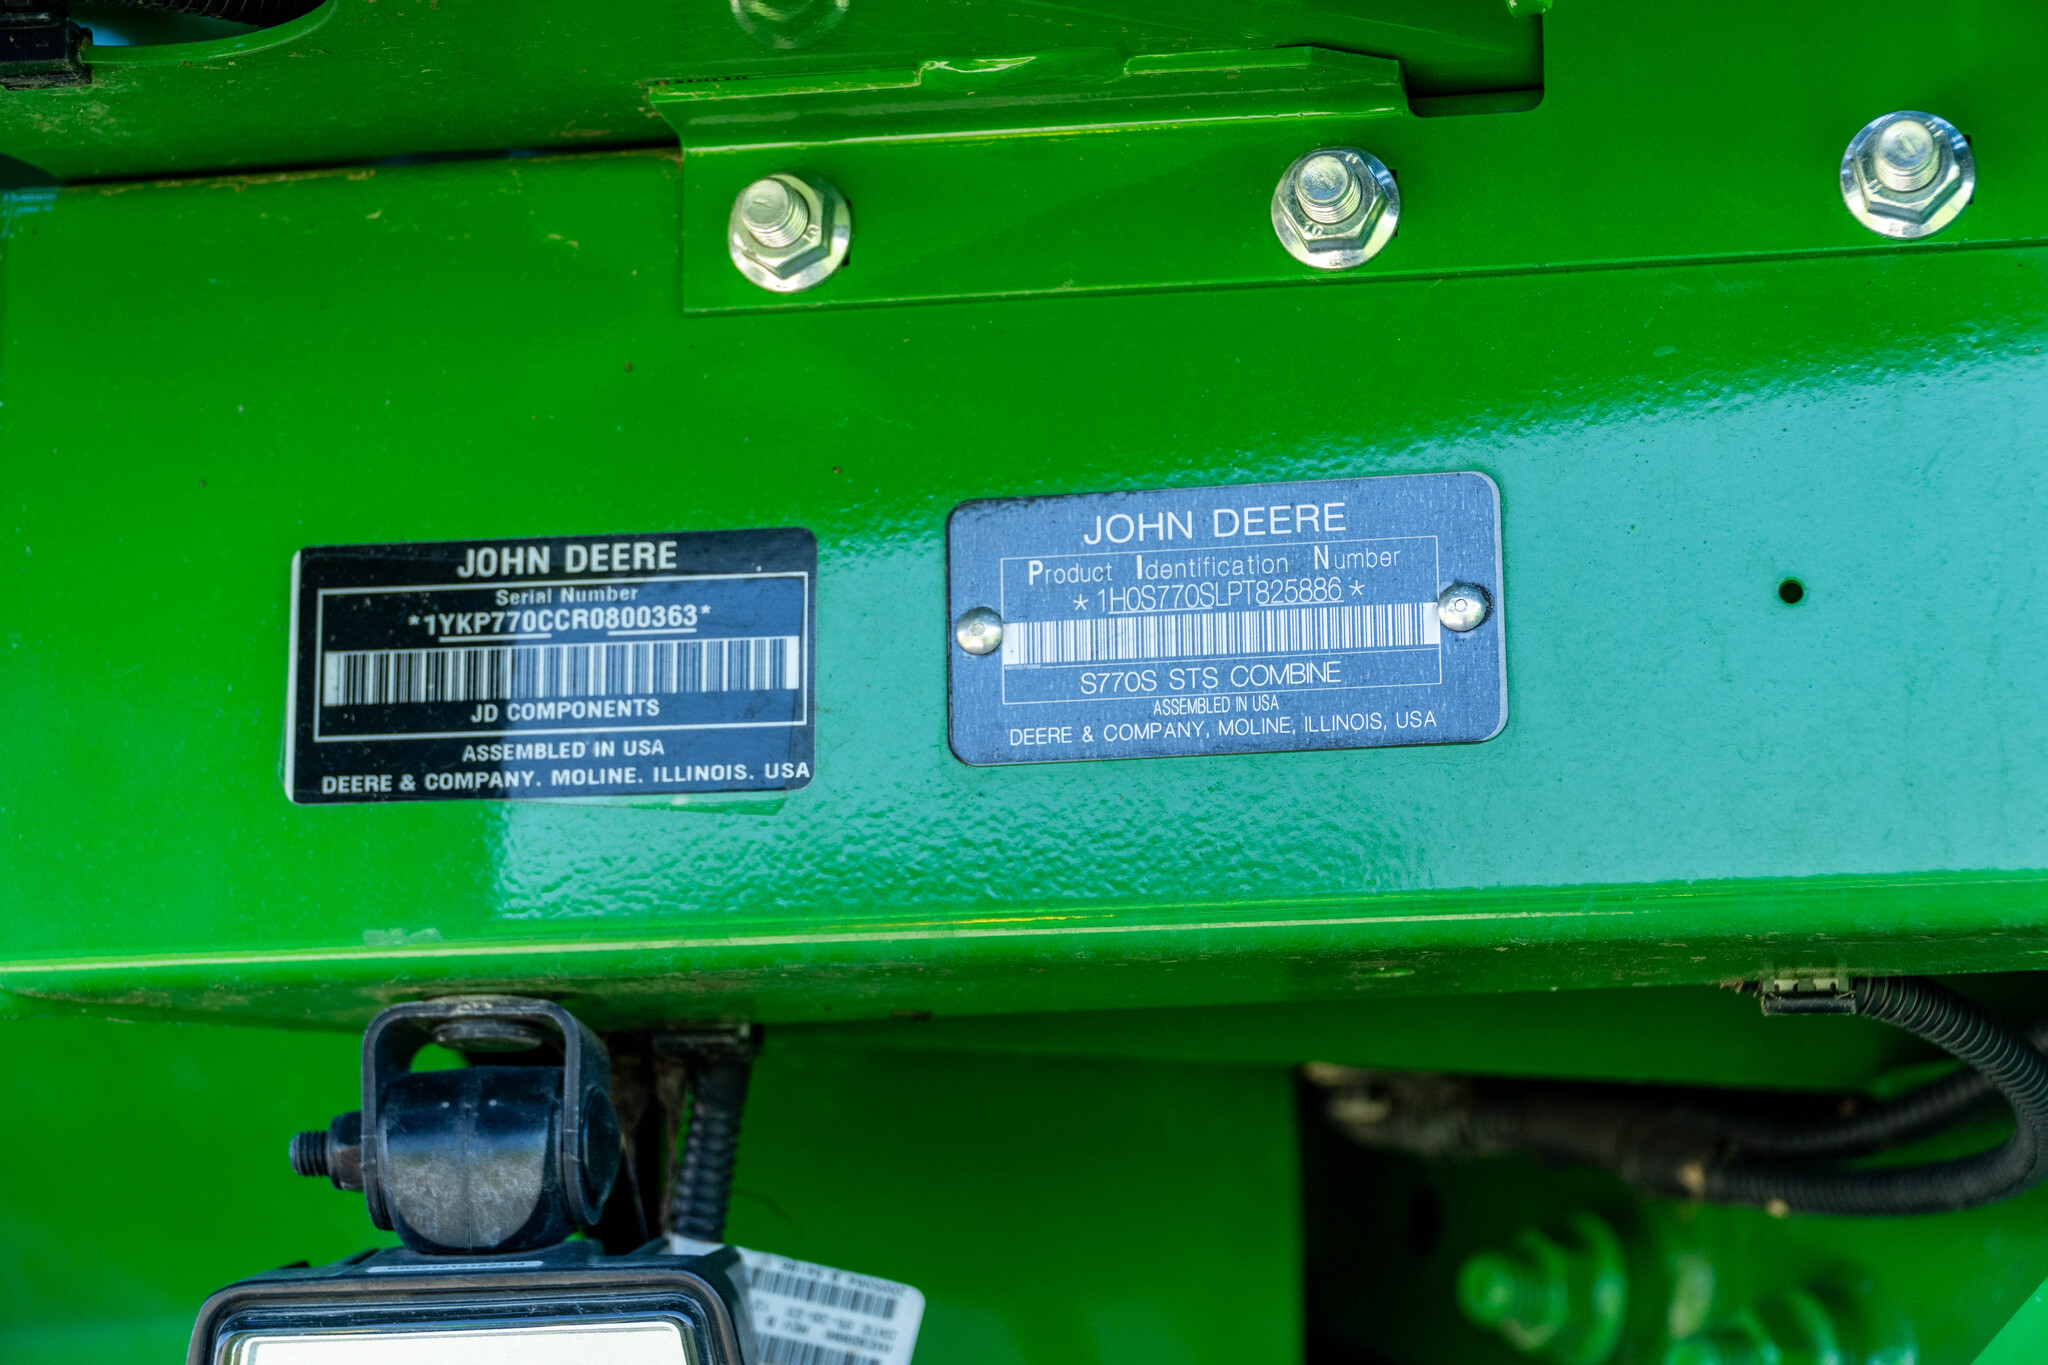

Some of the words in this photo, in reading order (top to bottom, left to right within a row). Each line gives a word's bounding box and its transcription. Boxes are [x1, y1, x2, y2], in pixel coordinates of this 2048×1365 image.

[1084, 511, 1193, 544] JOHN
[1214, 503, 1346, 537] DEERE
[456, 546, 550, 578] JOHN
[565, 541, 677, 572] DEERE
[1028, 560, 1113, 585] Product
[1137, 554, 1288, 580] Identification
[1314, 545, 1400, 570] Number
[496, 588, 552, 606] Serial
[560, 586, 638, 602] Number
[1081, 669, 1157, 694] S770S
[1169, 667, 1219, 690] STS
[1230, 661, 1341, 687] COMBINE
[470, 704, 498, 723] JD
[506, 698, 660, 721] COMPONENTS
[1153, 696, 1230, 715] ASSEMBLED
[1236, 696, 1247, 711] IN
[1252, 694, 1279, 711] USA
[1010, 727, 1072, 746] DEERE
[1082, 726, 1094, 743] &
[1104, 721, 1210, 741] COMPANY,
[1219, 716, 1296, 735] MOLINE,
[1305, 712, 1387, 732] ILLINOIS,
[1396, 711, 1436, 728] USA
[462, 742, 586, 762] ASSEMBLED
[594, 741, 615, 757] IN
[623, 739, 665, 756] USA
[321, 775, 392, 794] DEERE
[399, 773, 416, 791] &
[764, 762, 810, 779] USA
